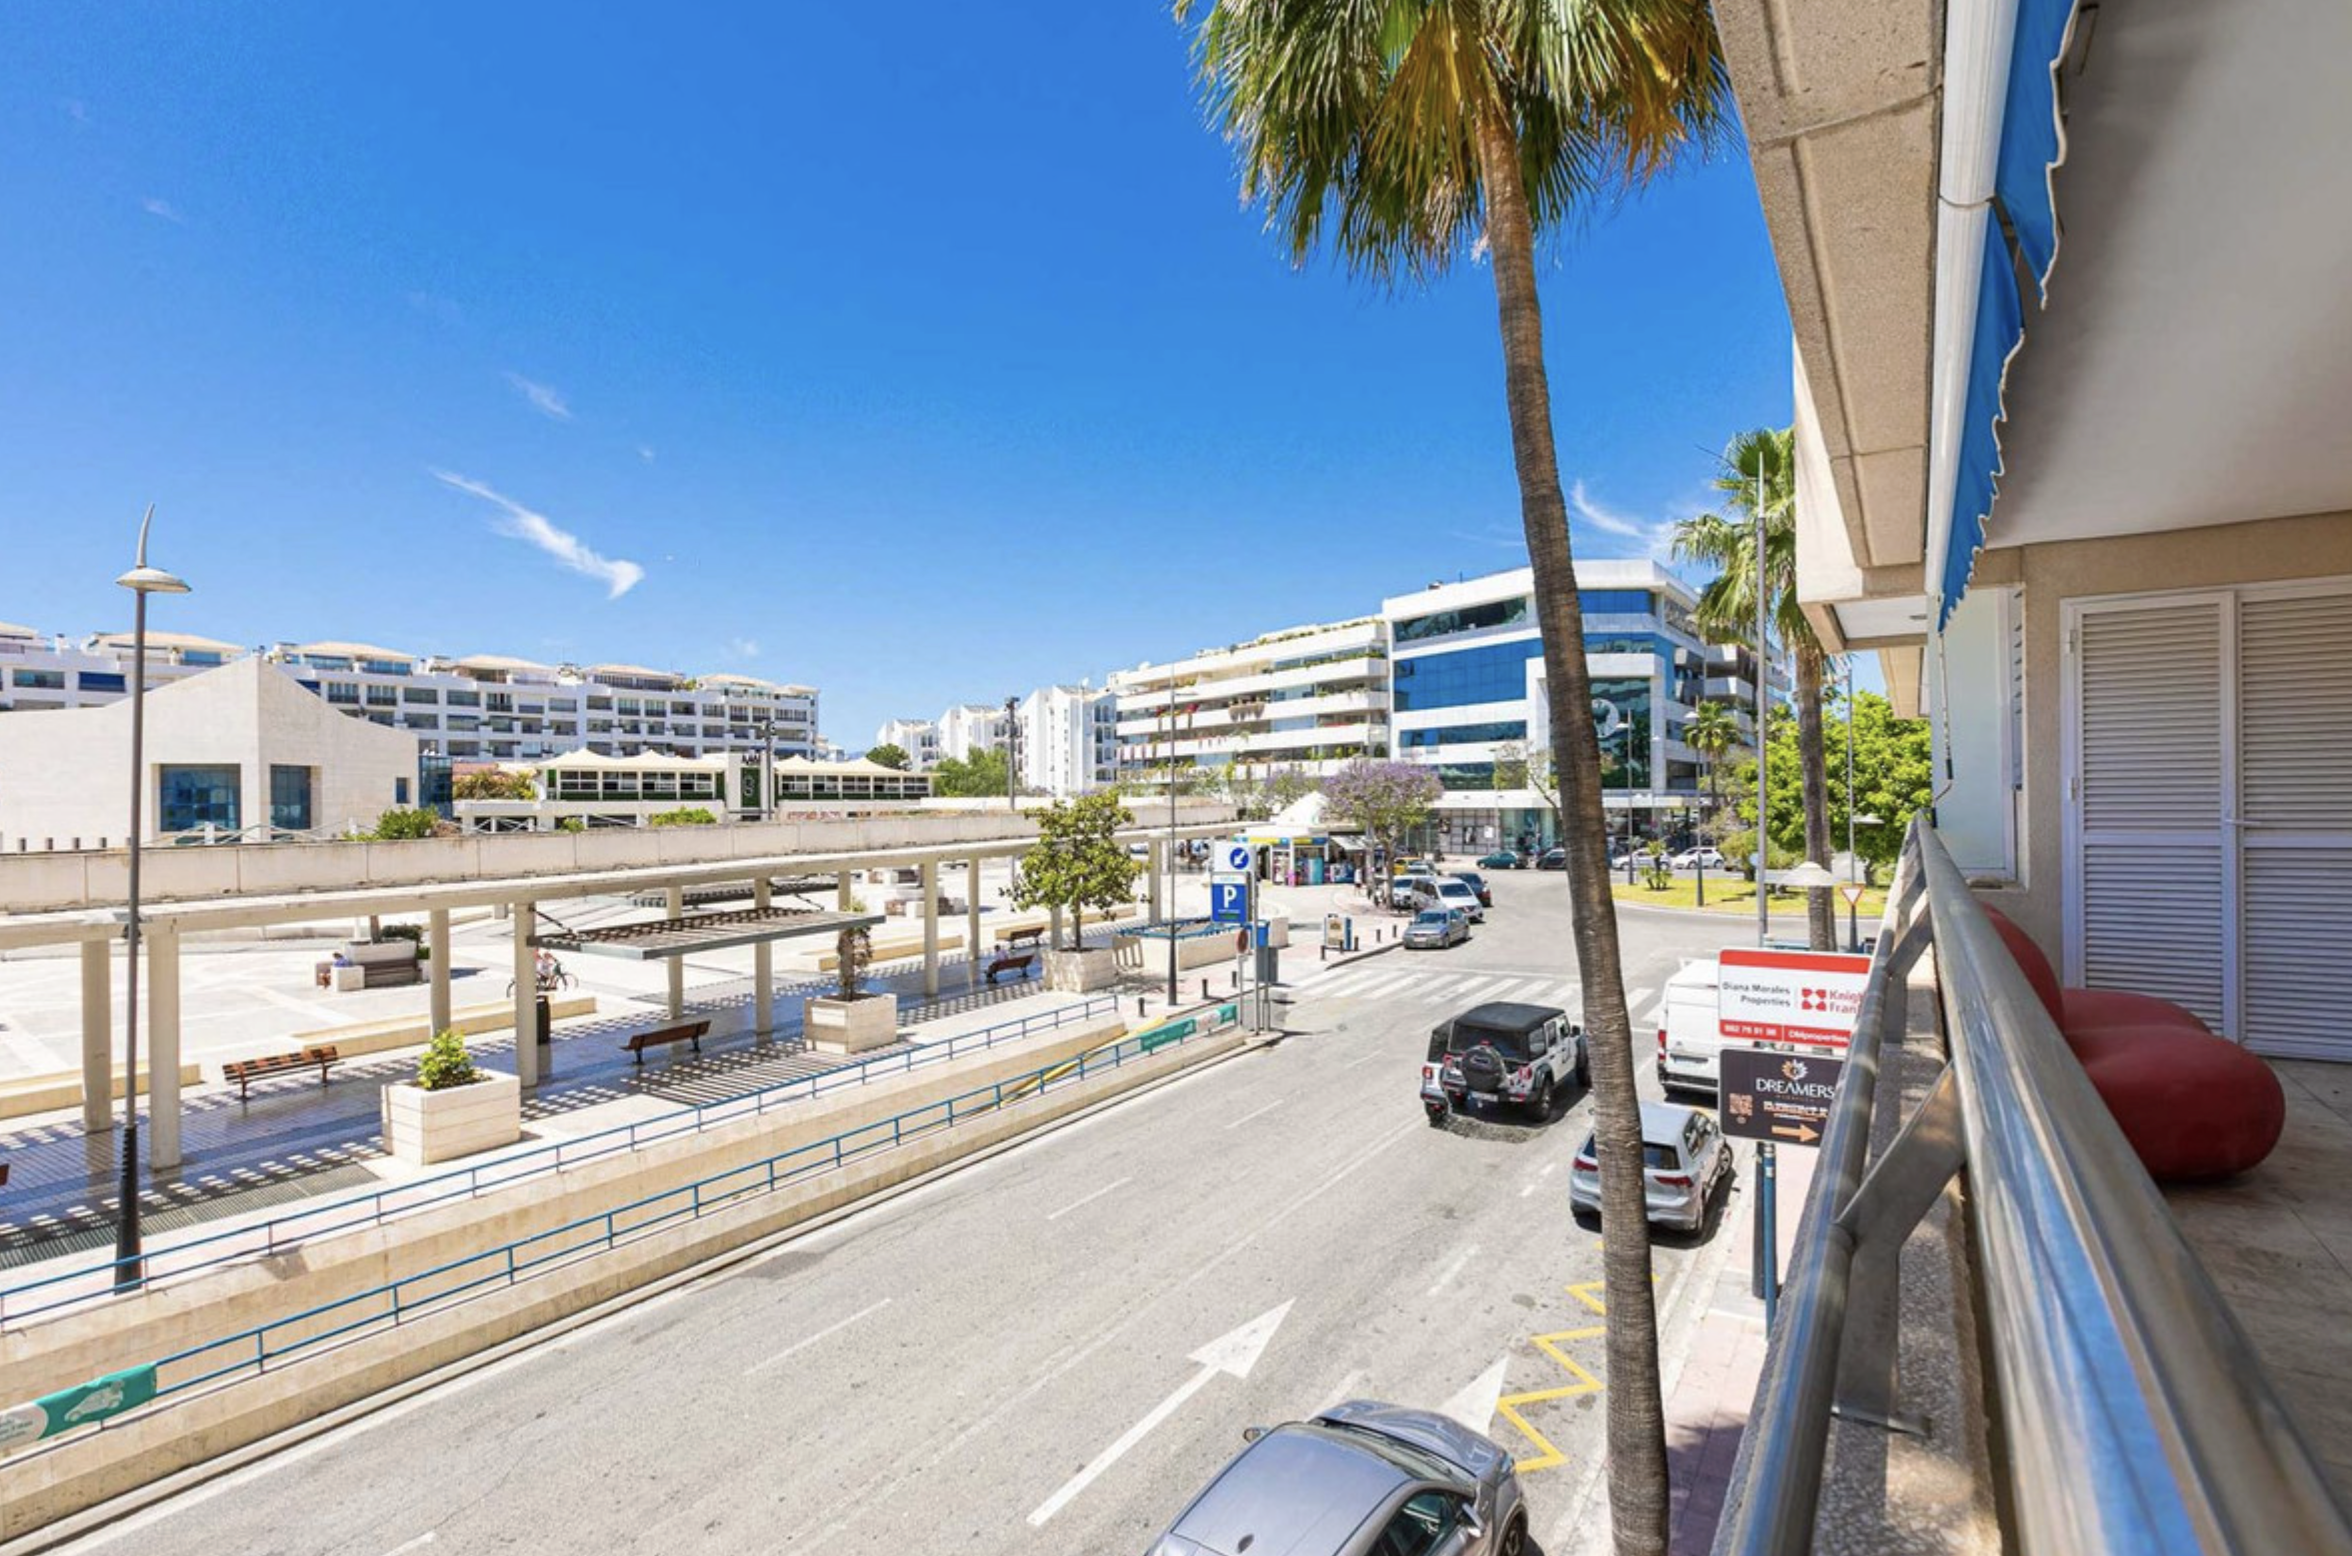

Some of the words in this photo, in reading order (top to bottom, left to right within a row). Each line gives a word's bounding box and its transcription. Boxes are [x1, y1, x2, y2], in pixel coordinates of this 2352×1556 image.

[1223, 885, 1237, 909] P
[1722, 981, 1749, 992] Diana
[1752, 983, 1791, 995] Morales
[1740, 994, 1791, 1008] Properties
[1755, 1077, 1836, 1099] DREAMERS
